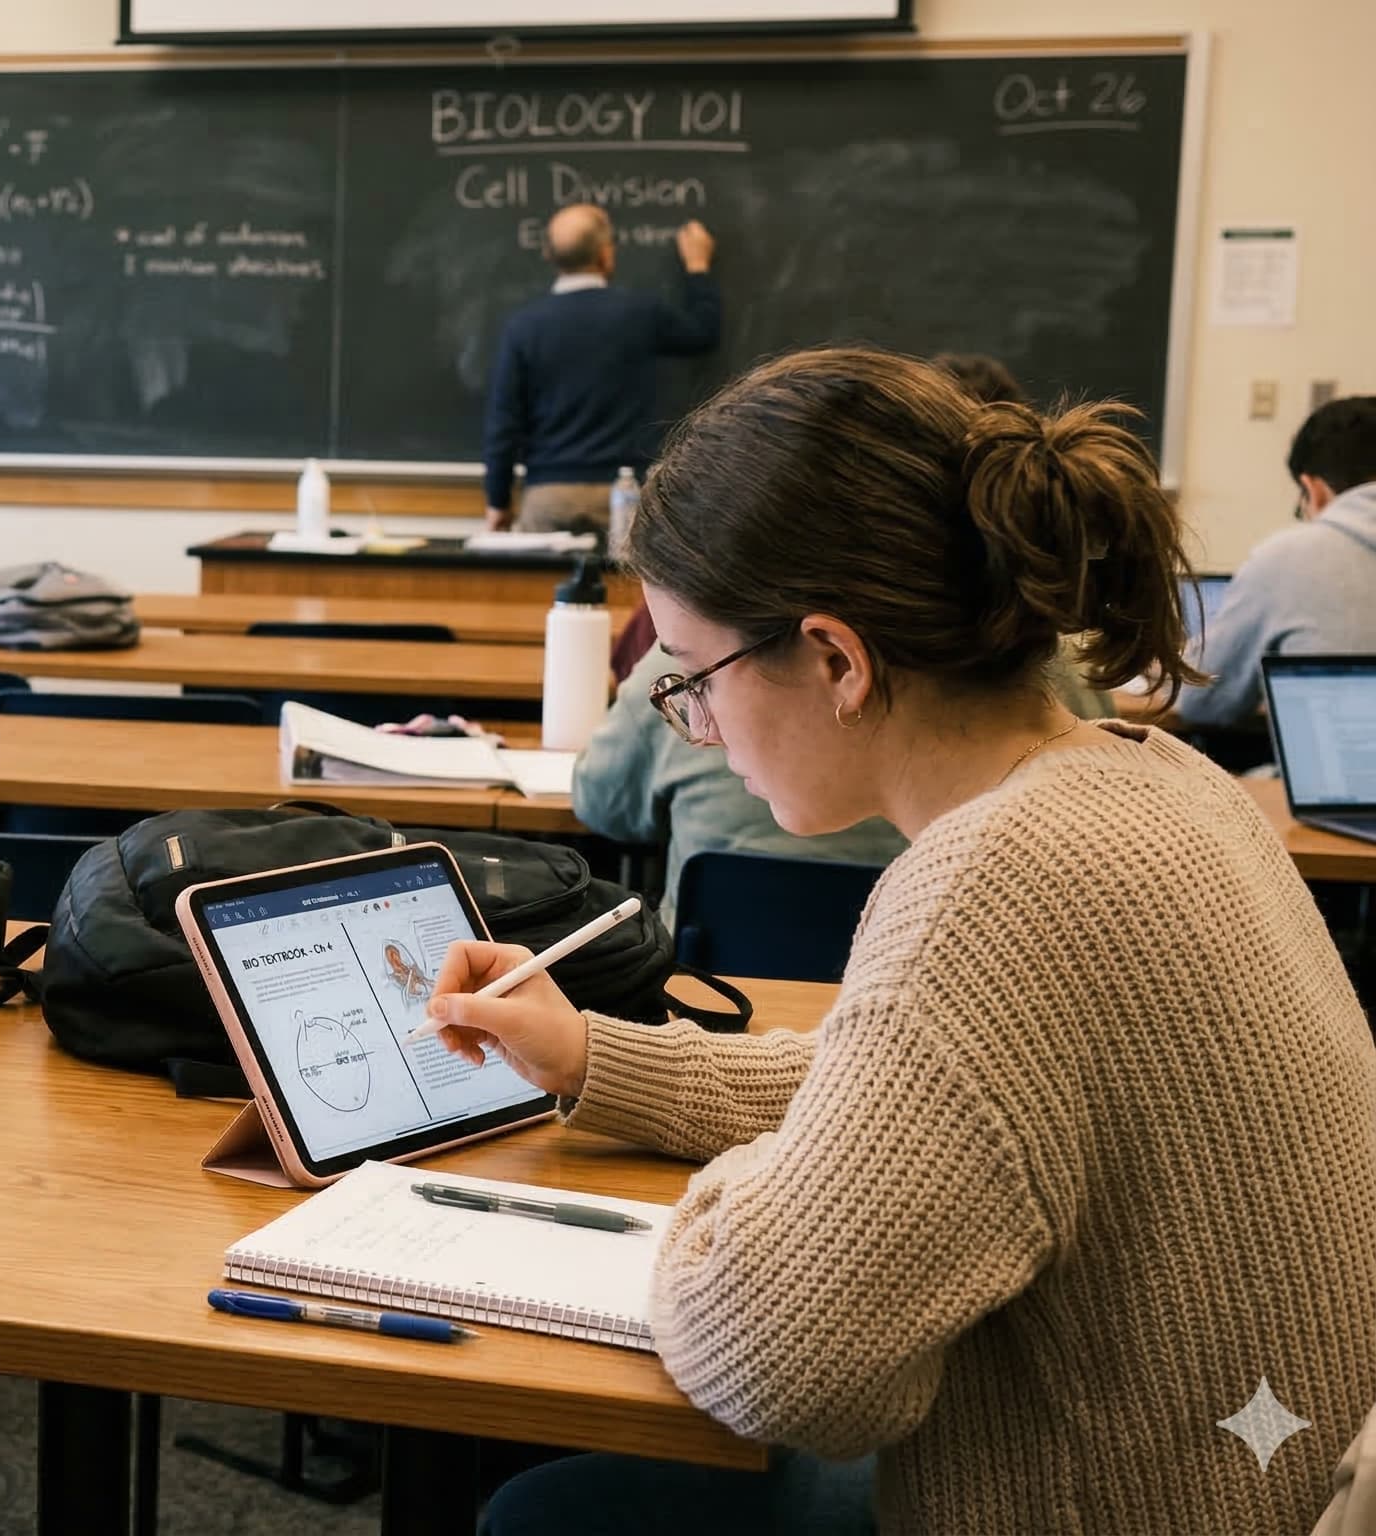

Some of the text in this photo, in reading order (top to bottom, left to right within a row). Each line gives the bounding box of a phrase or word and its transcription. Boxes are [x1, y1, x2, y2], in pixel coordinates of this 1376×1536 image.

[432, 89, 743, 143] BIOLOGY 101
[993, 72, 1147, 120] Oct 26
[455, 161, 707, 208] Cell Division
[313, 943, 326, 954] Ch
